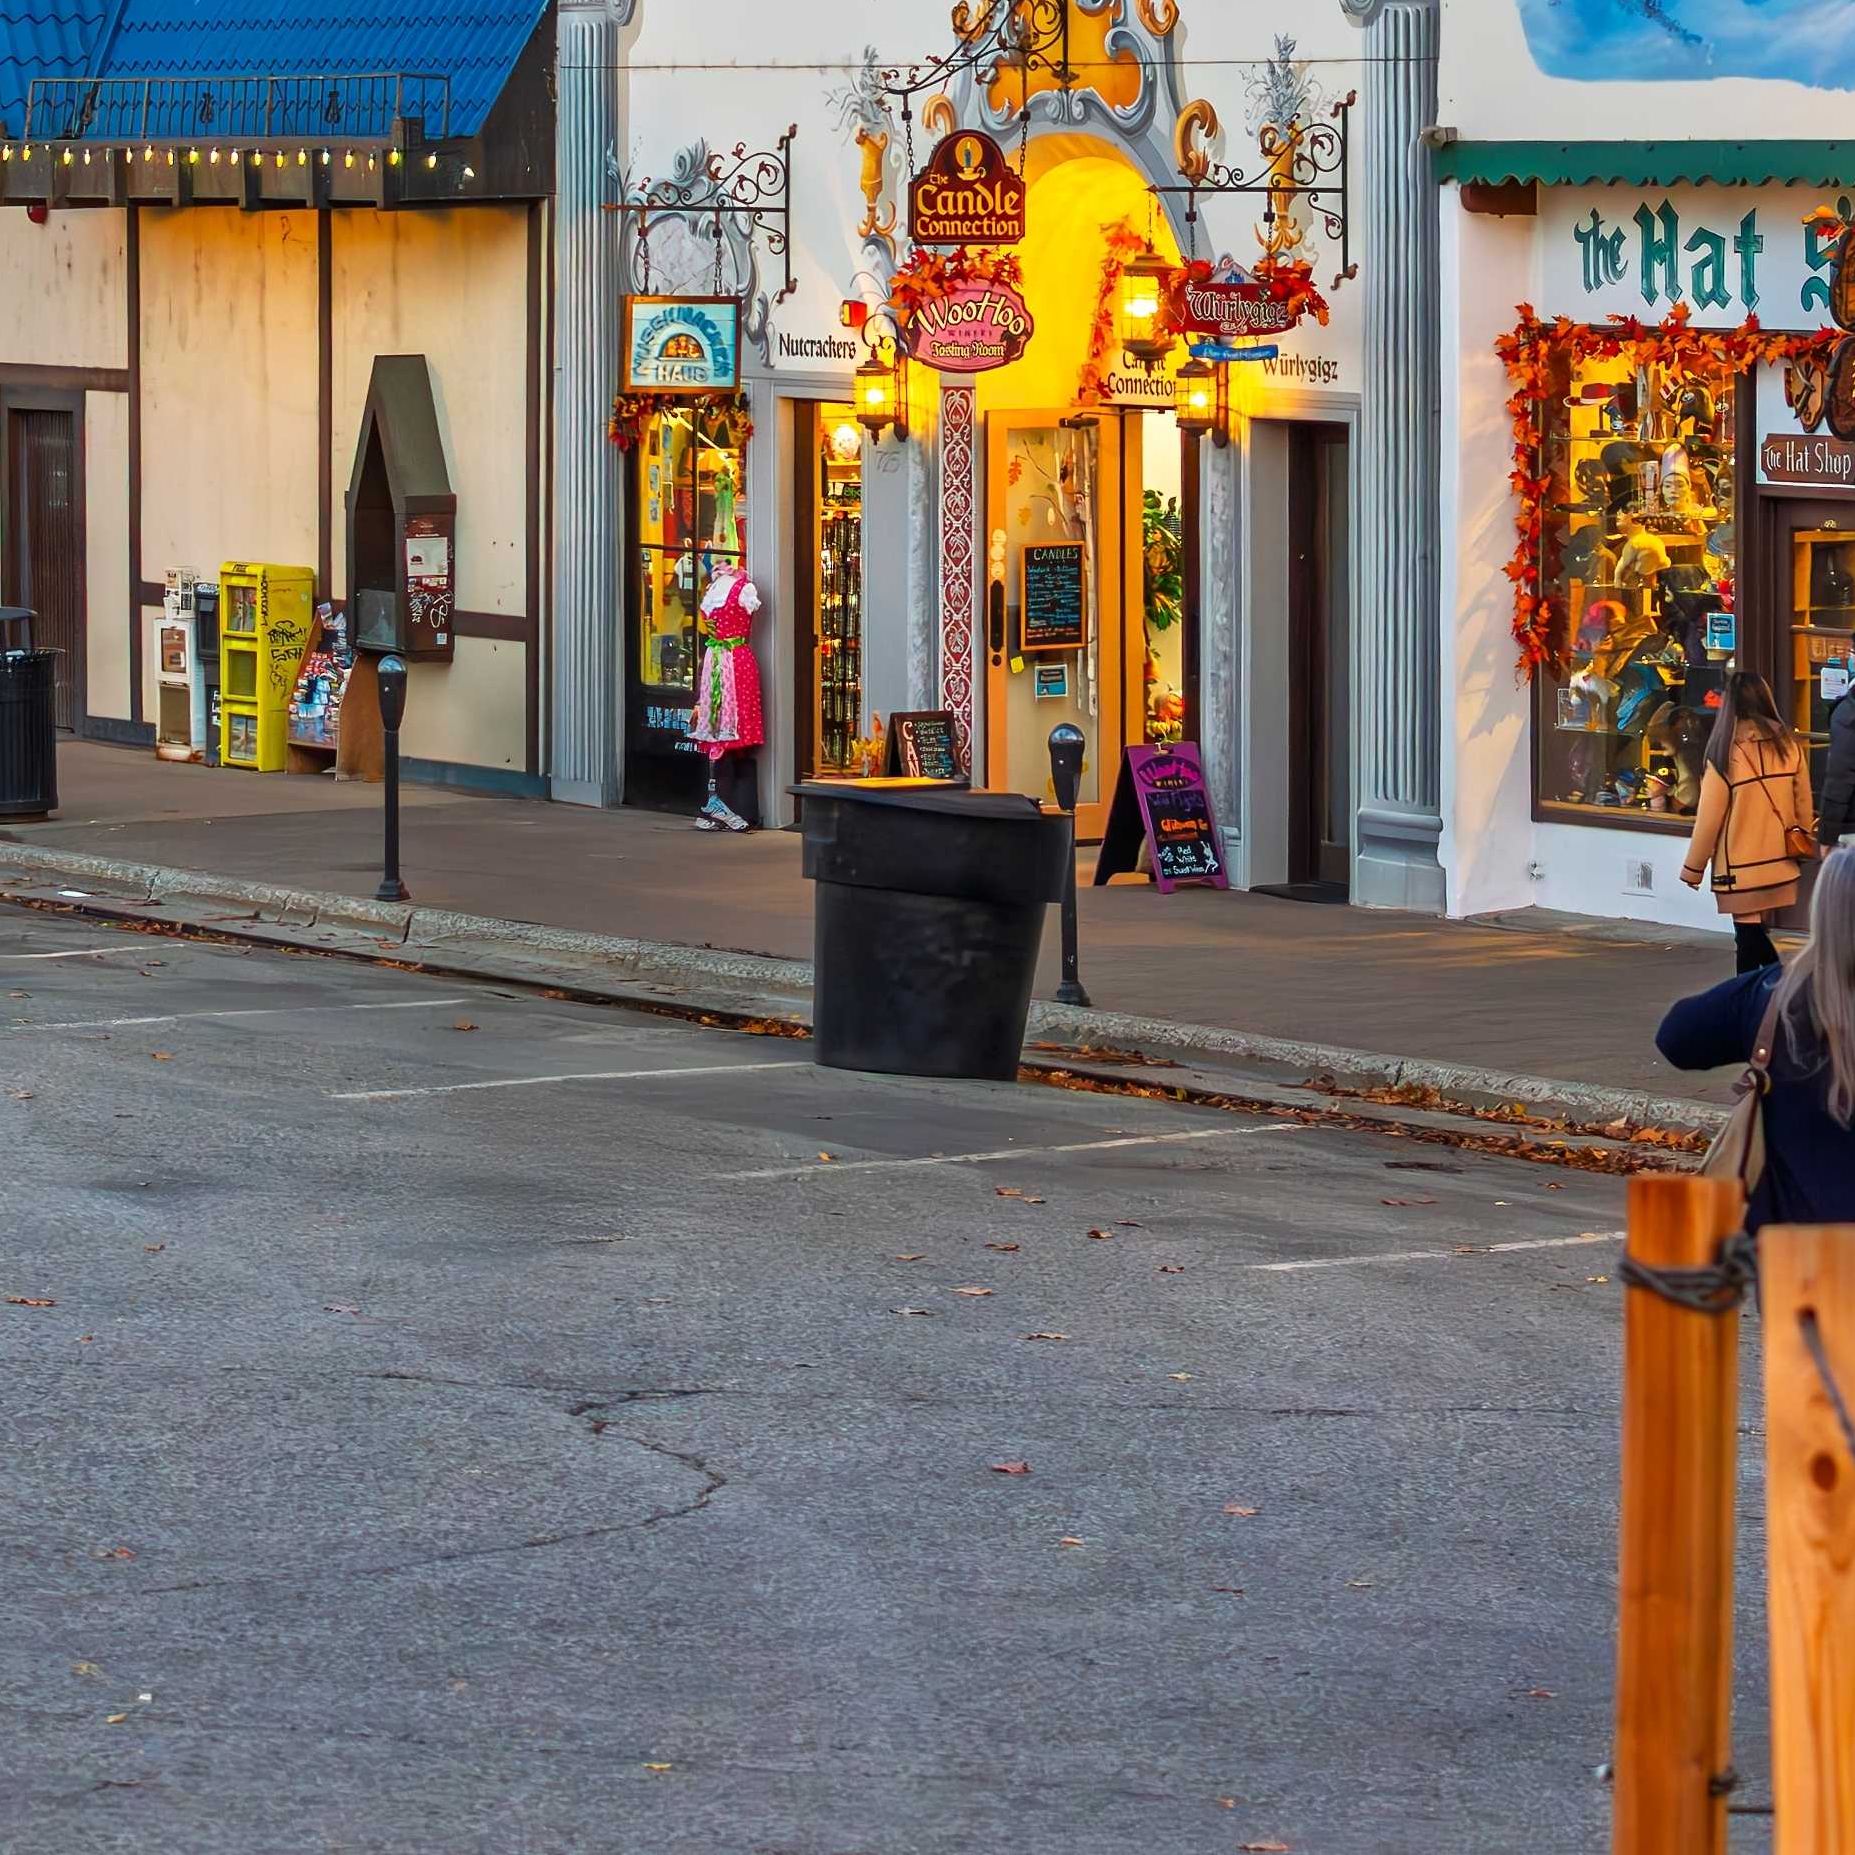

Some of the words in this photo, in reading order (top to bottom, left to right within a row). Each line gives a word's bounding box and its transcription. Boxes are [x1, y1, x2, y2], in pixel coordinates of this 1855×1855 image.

[916, 181, 1021, 216] Candle
[916, 216, 1021, 237] Connection
[1633, 198, 1764, 312] Hat
[907, 291, 1026, 336] WooHoo
[1186, 285, 1290, 332] Würlygigz
[779, 332, 857, 359] Nutcrackers
[948, 329, 993, 337] WINERY
[931, 342, 971, 359] Tasting
[972, 342, 1006, 357] Room
[656, 363, 708, 382] HAUS
[1263, 352, 1339, 383] Würlygigz
[1763, 446, 1782, 471] The
[1786, 441, 1810, 473] Hat
[1814, 442, 1852, 481] Shop
[1033, 547, 1079, 561] CANDLES
